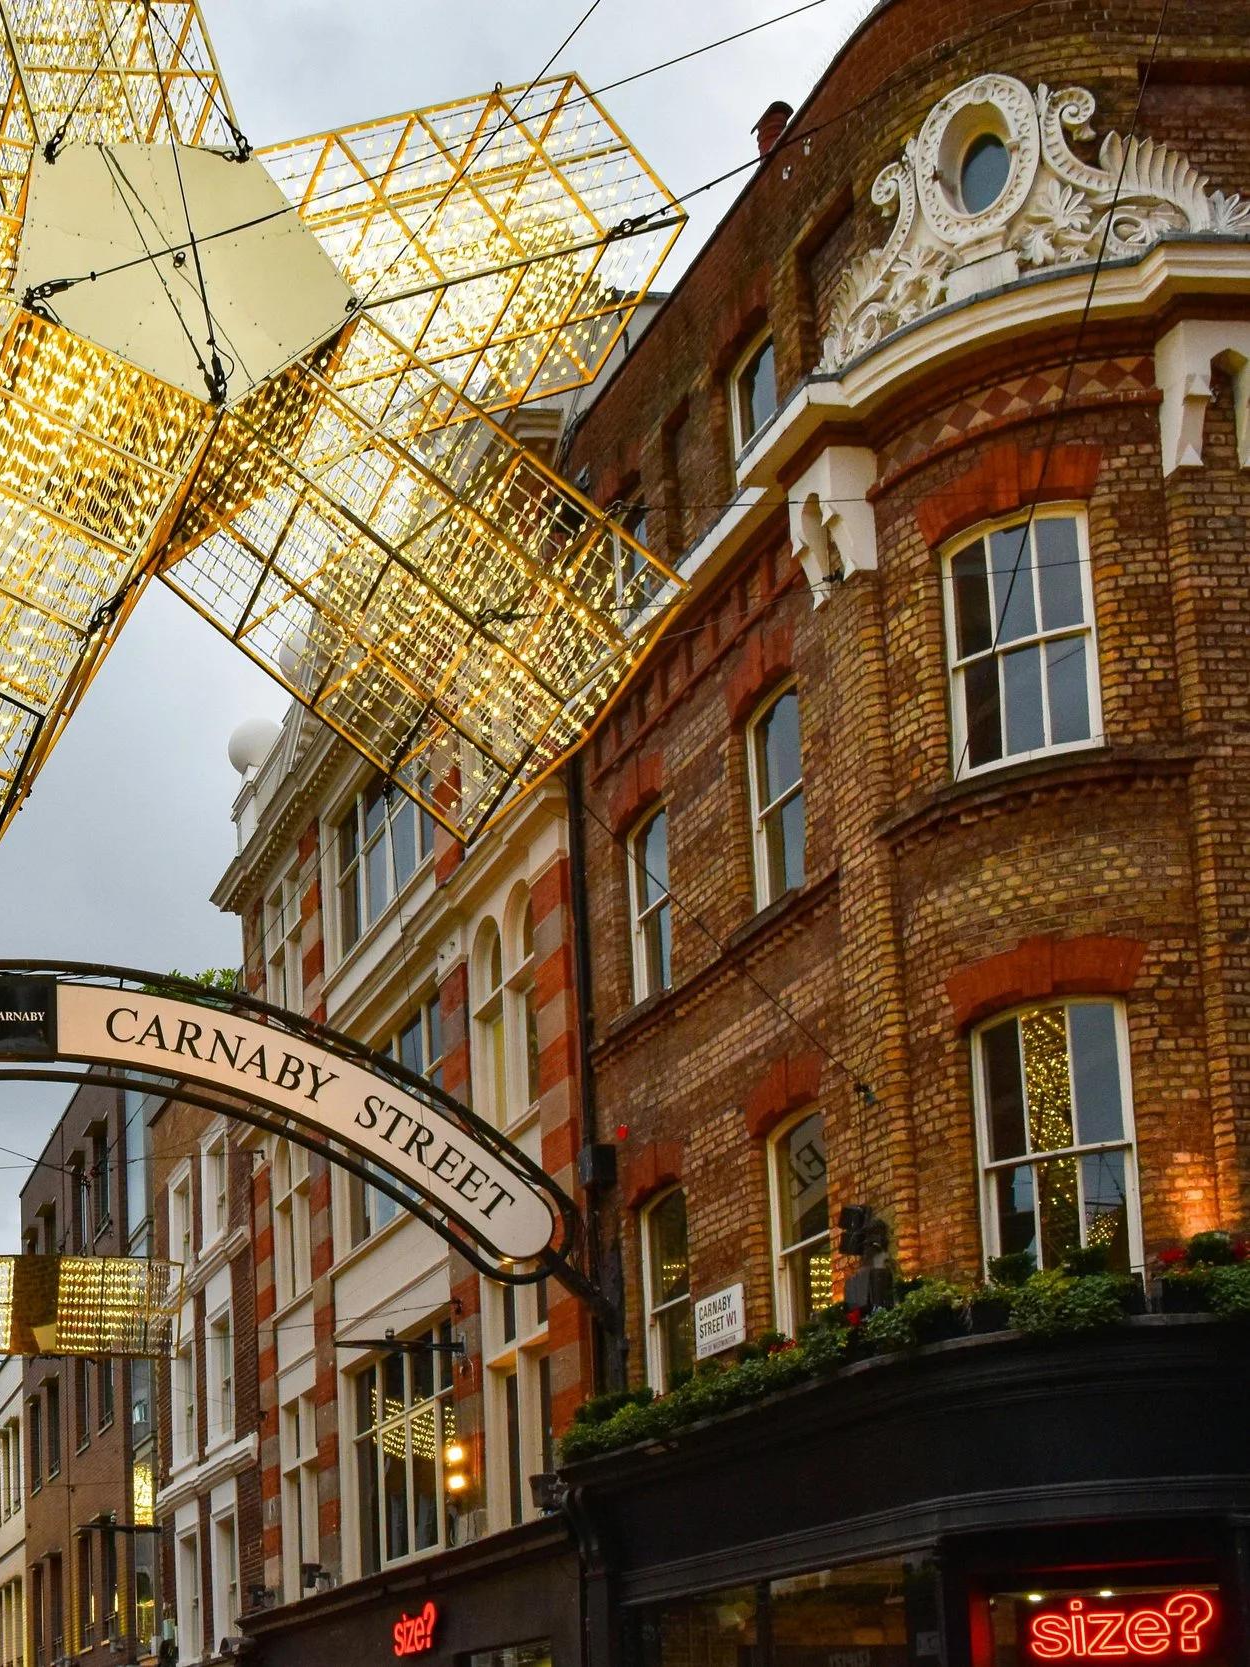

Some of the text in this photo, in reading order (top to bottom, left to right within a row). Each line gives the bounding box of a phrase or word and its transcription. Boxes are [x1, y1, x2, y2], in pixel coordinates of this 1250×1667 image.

[105, 1008, 340, 1103] CARNABY
[354, 1095, 516, 1220] STREET
[699, 1293, 732, 1321] CARNABY
[699, 1310, 737, 1339] STREET W1
[394, 1602, 436, 1656] size?
[1031, 1593, 1213, 1658] size?
